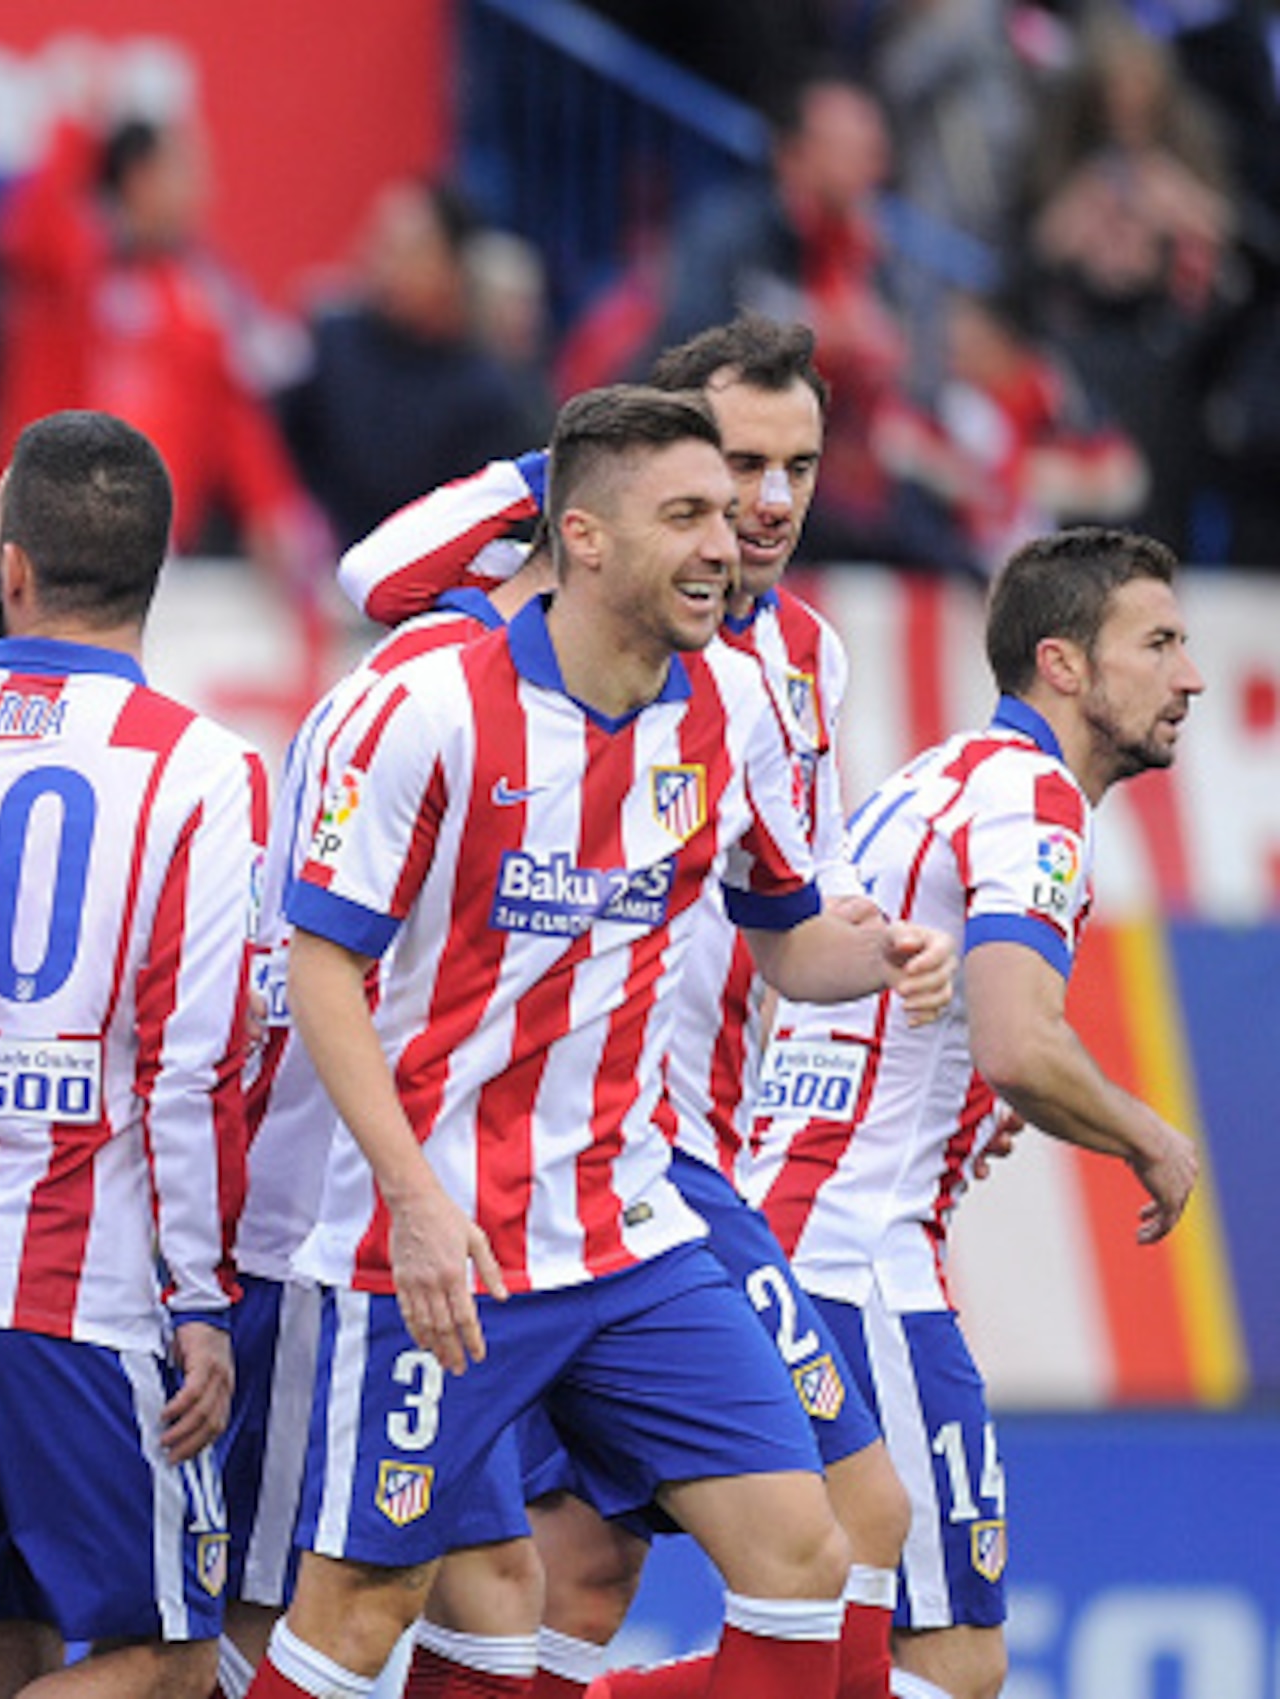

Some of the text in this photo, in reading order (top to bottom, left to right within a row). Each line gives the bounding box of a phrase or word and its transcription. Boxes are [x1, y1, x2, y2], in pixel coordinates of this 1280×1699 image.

[499, 857, 597, 905] Baku
[746, 1264, 819, 1364] 2
[386, 1350, 444, 1451] 3
[933, 1420, 1006, 1524] 14
